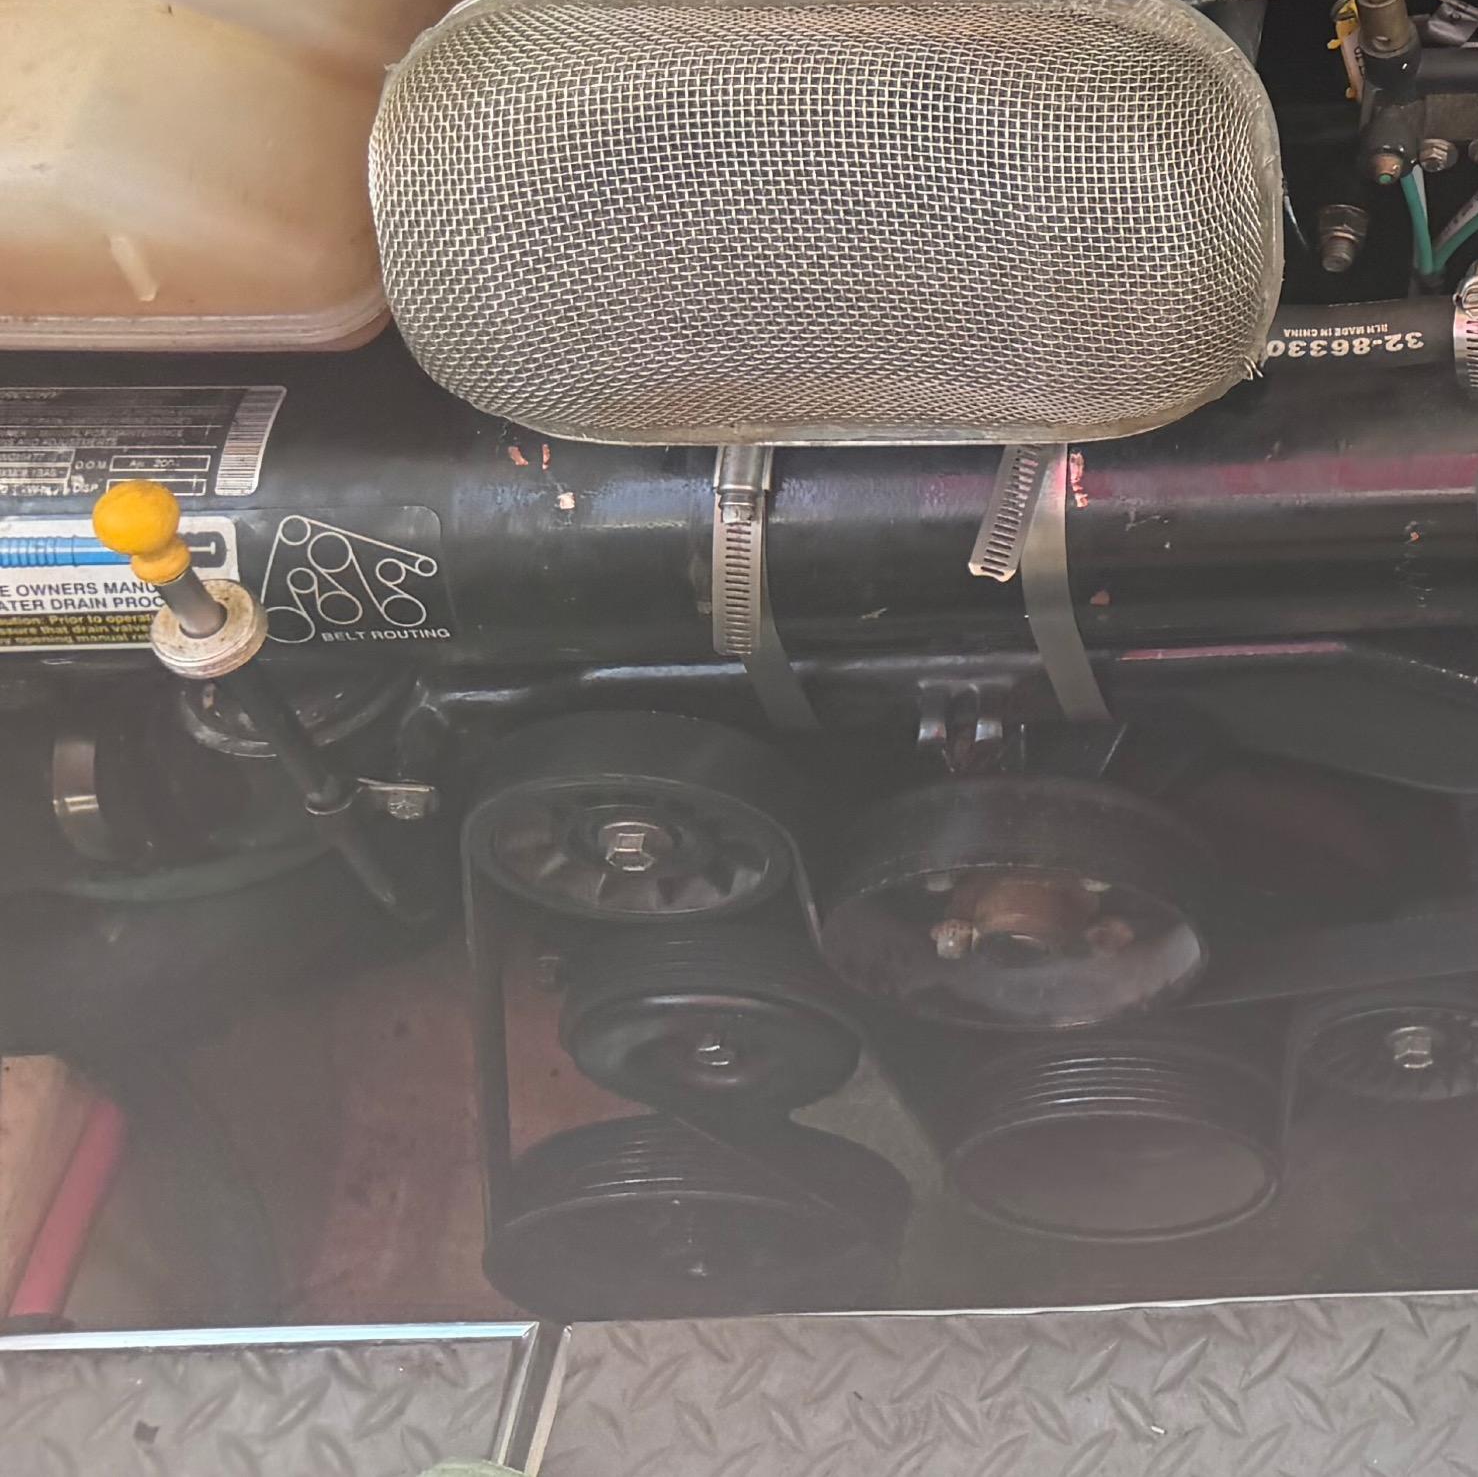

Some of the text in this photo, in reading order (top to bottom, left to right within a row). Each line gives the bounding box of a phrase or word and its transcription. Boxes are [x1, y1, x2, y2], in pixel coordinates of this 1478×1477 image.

[16, 582, 98, 597] OWNERS
[53, 597, 117, 610] DRAIN
[322, 628, 450, 641] BELT ROUTING
